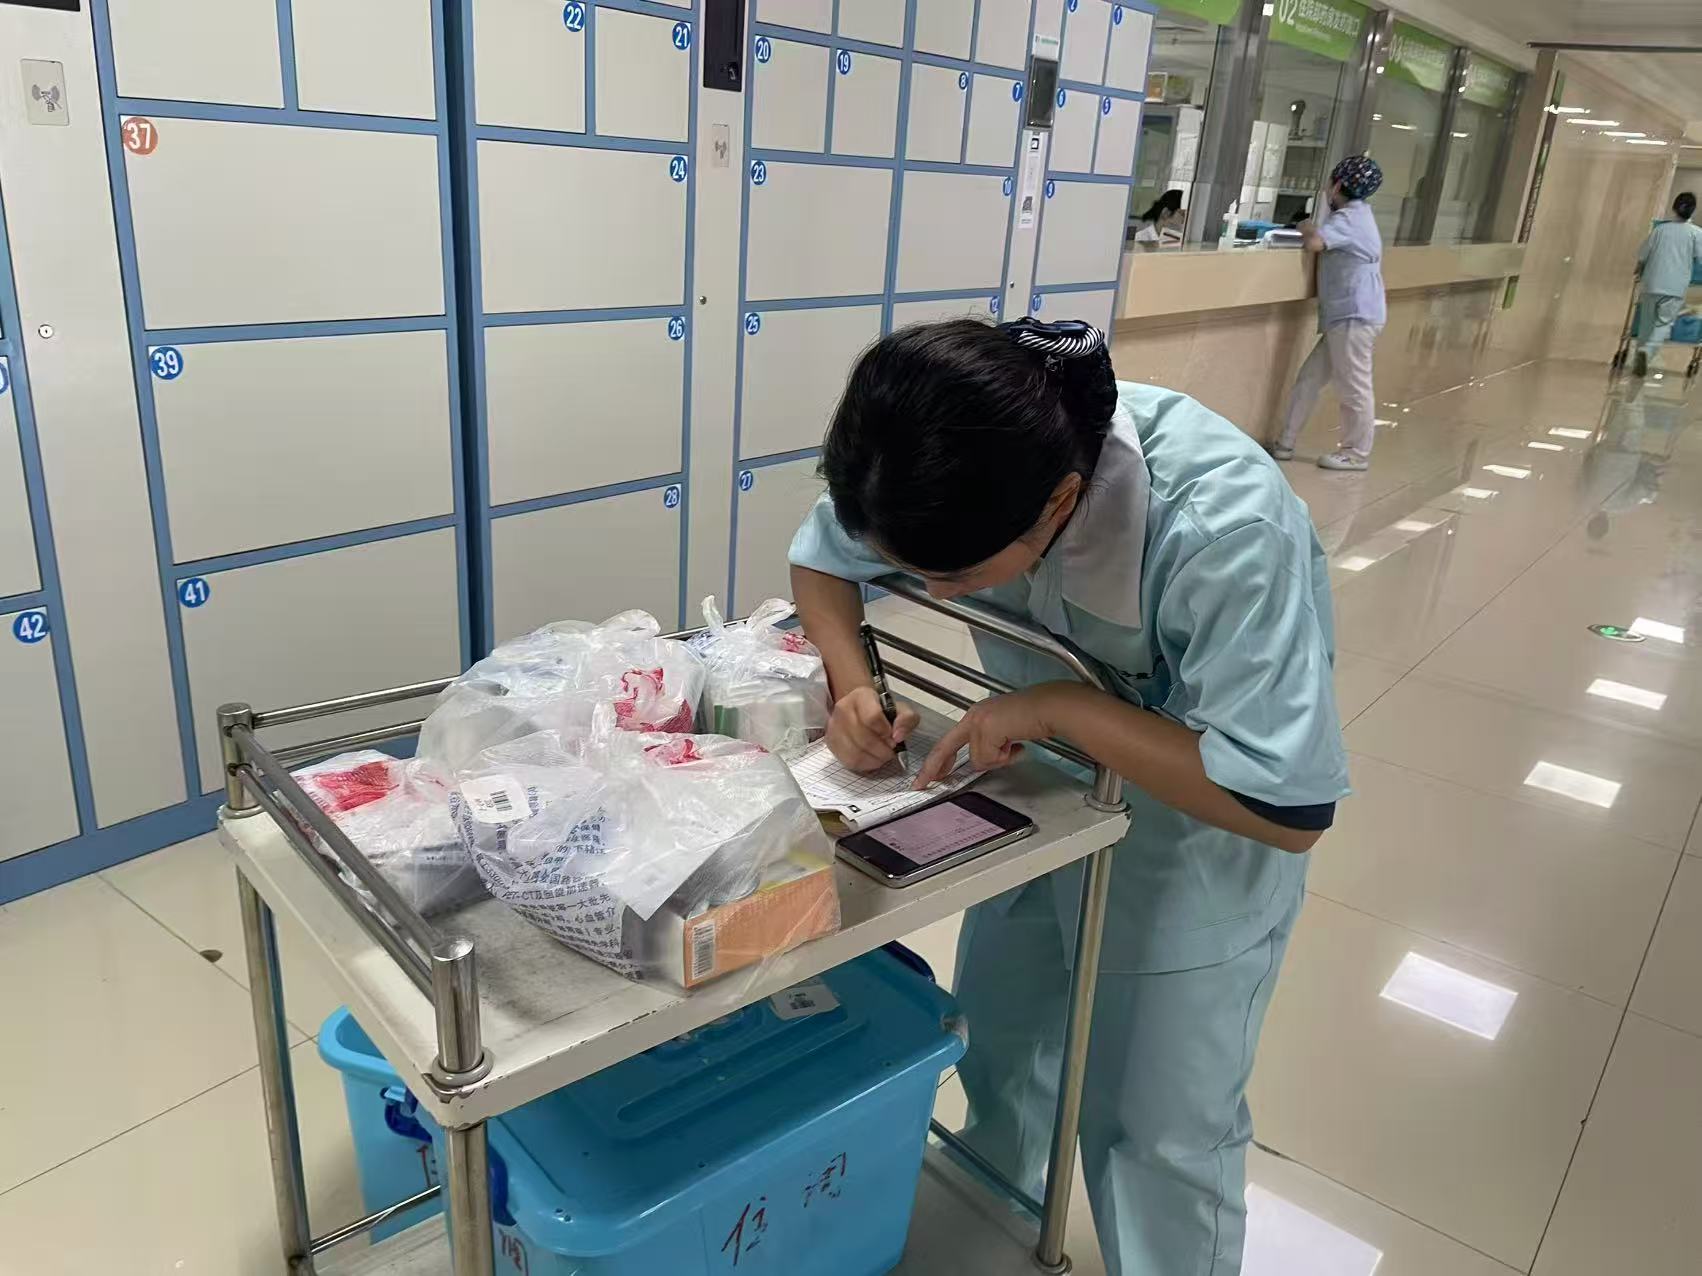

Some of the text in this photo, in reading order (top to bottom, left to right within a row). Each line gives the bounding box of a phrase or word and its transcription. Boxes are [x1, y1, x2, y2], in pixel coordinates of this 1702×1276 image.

[566, 3, 584, 30] 22
[675, 26, 688, 46] 21
[757, 38, 770, 61] 20
[839, 52, 849, 72] 19
[960, 72, 967, 88] 8
[128, 122, 152, 150] 37
[672, 159, 686, 180] 24
[753, 163, 765, 183] 23
[670, 319, 682, 341] 26
[747, 313, 759, 333] 25
[154, 350, 179, 377] 39
[742, 473, 752, 490] 27
[667, 490, 678, 506] 28
[184, 580, 206, 605] 41
[19, 614, 45, 640] 42
